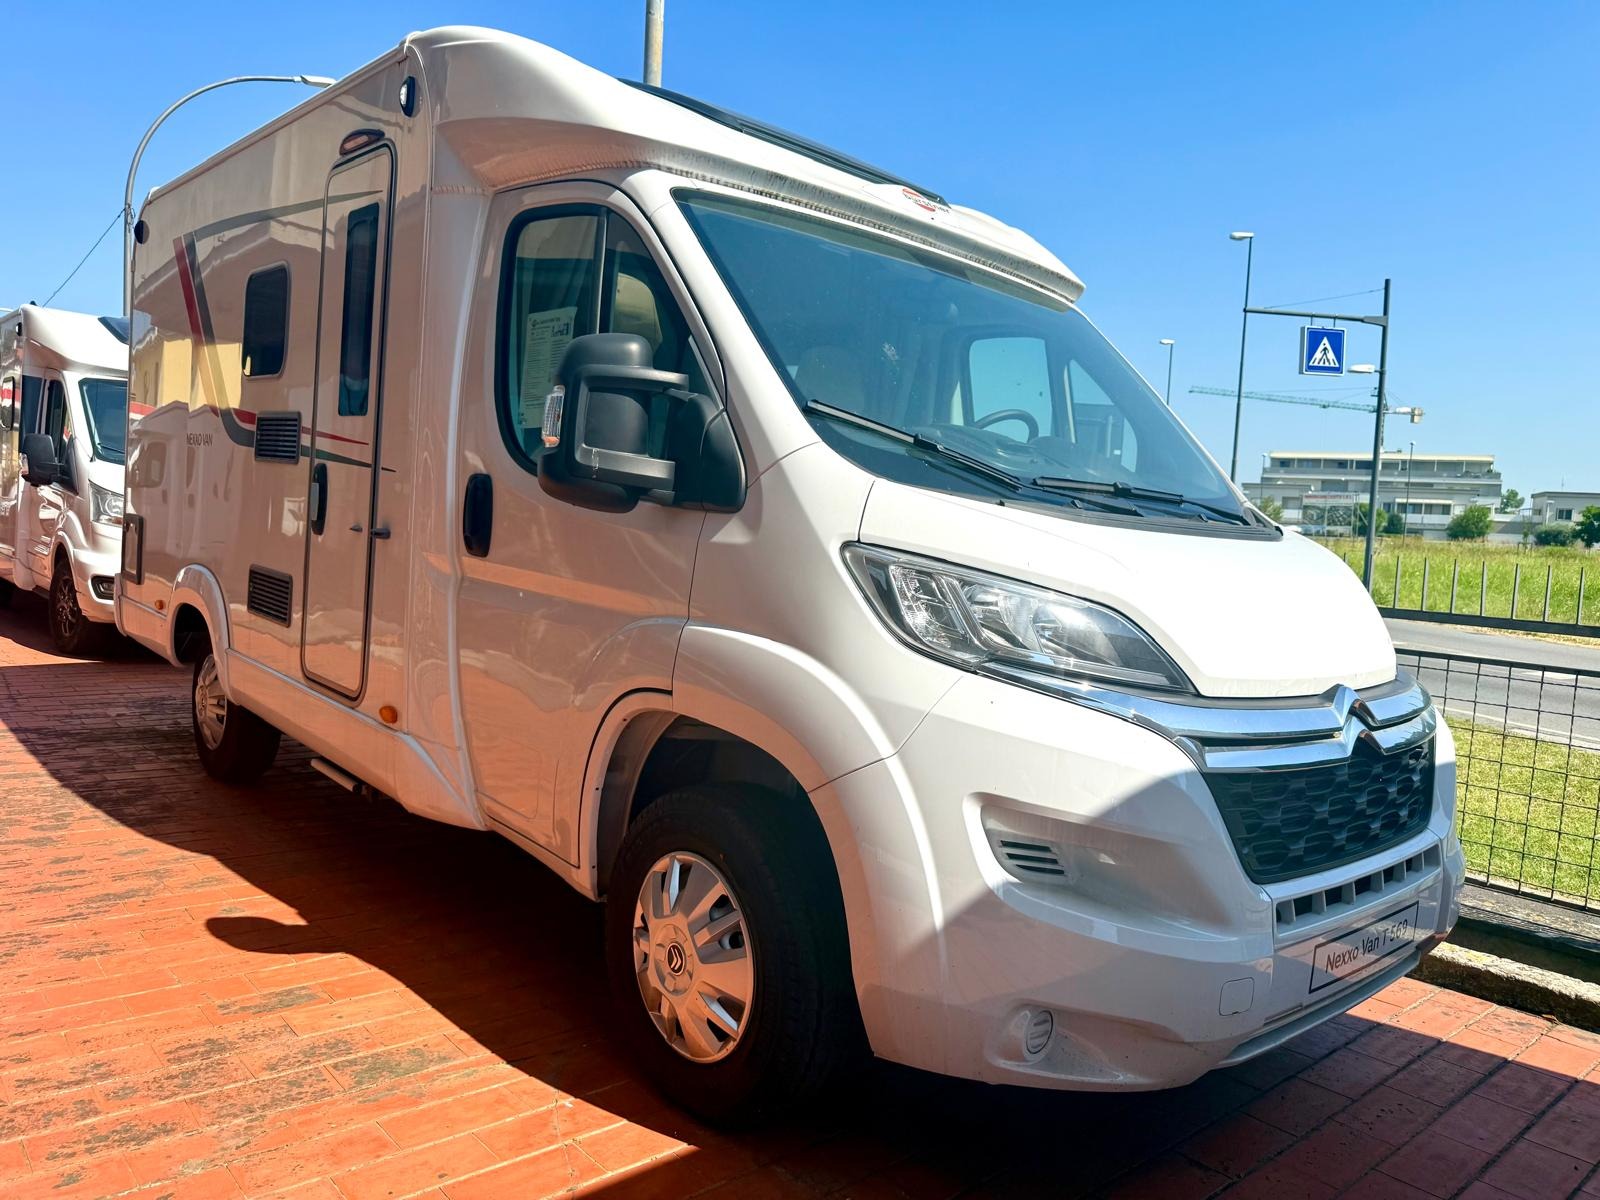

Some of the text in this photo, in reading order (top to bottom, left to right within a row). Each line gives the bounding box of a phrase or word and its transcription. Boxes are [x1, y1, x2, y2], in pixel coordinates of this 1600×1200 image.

[203, 433, 213, 447] VAN
[1325, 946, 1359, 974] Nexxo
[1362, 936, 1380, 956] Van
